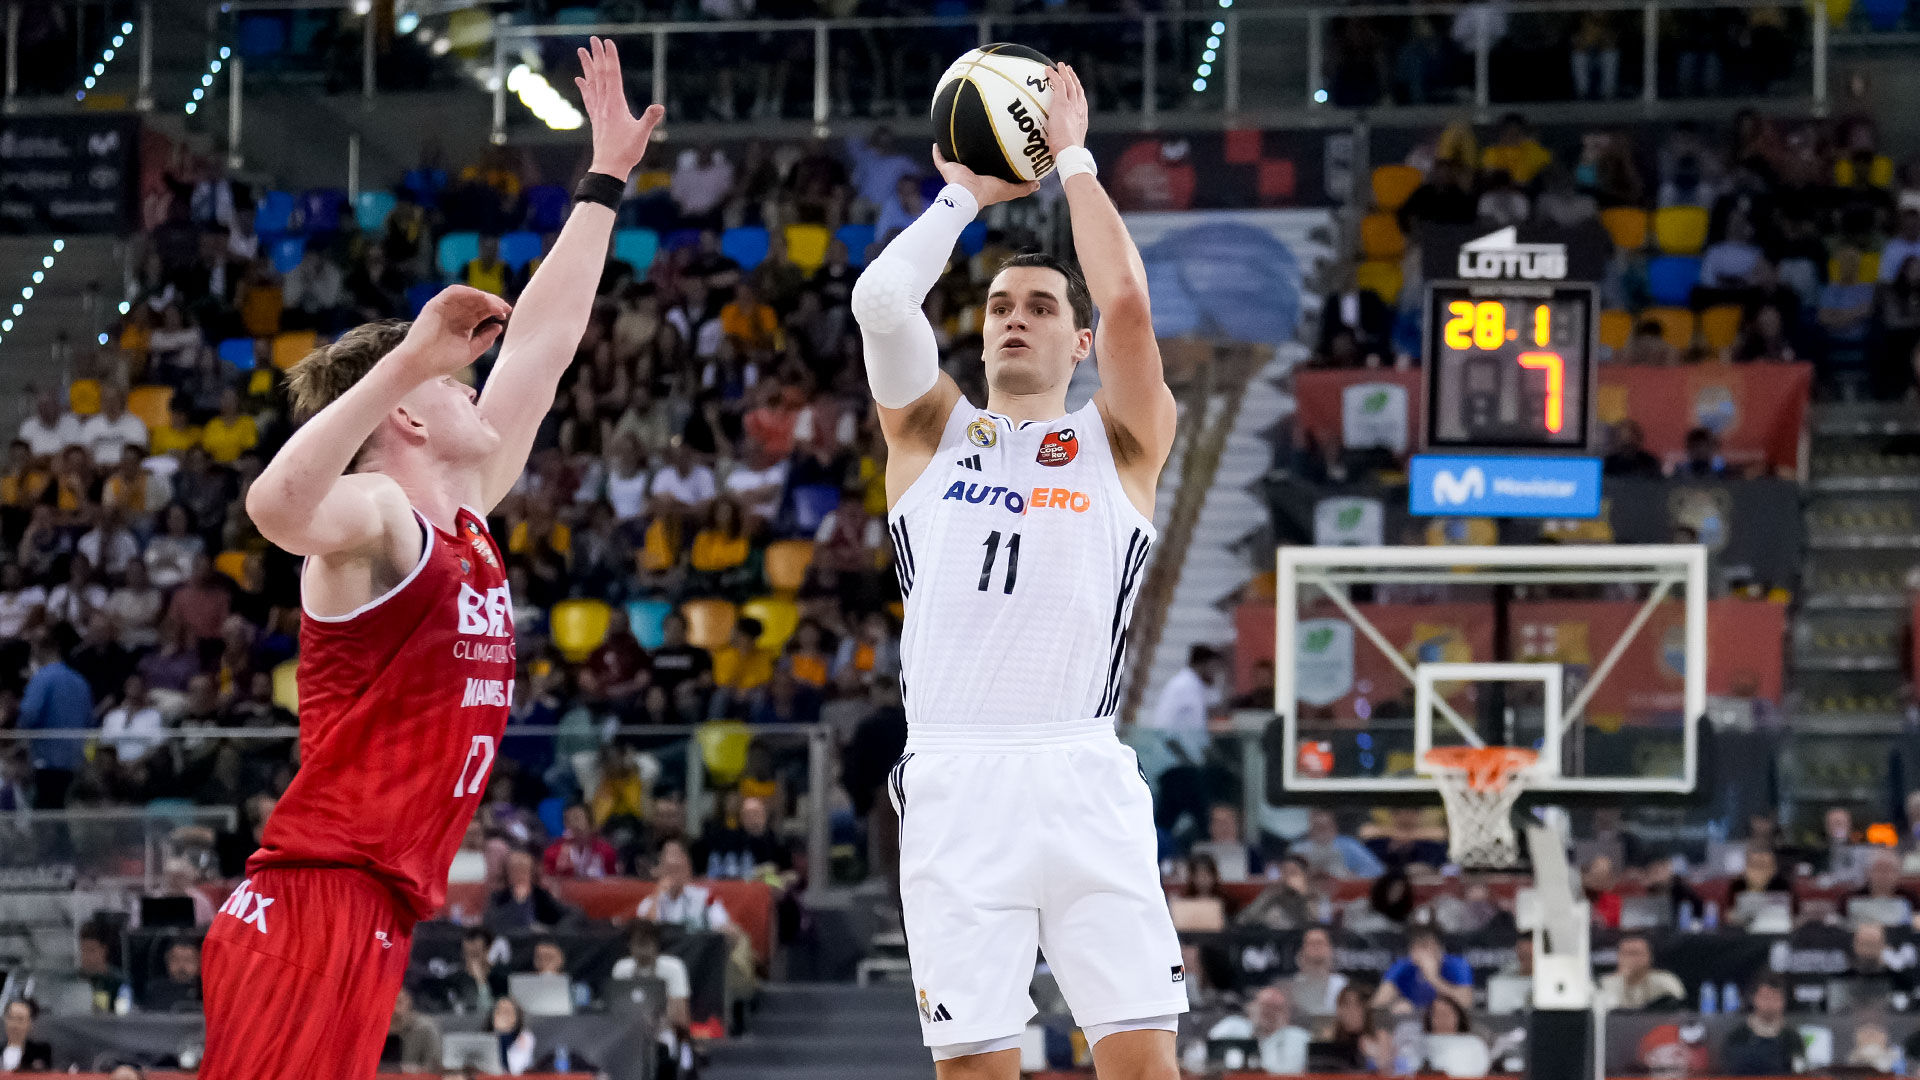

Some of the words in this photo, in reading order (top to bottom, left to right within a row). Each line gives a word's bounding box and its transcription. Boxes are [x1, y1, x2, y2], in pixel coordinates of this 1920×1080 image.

[1516, 351, 1566, 434] 7
[942, 480, 1091, 516] AUTOERO
[977, 530, 1021, 595] 11
